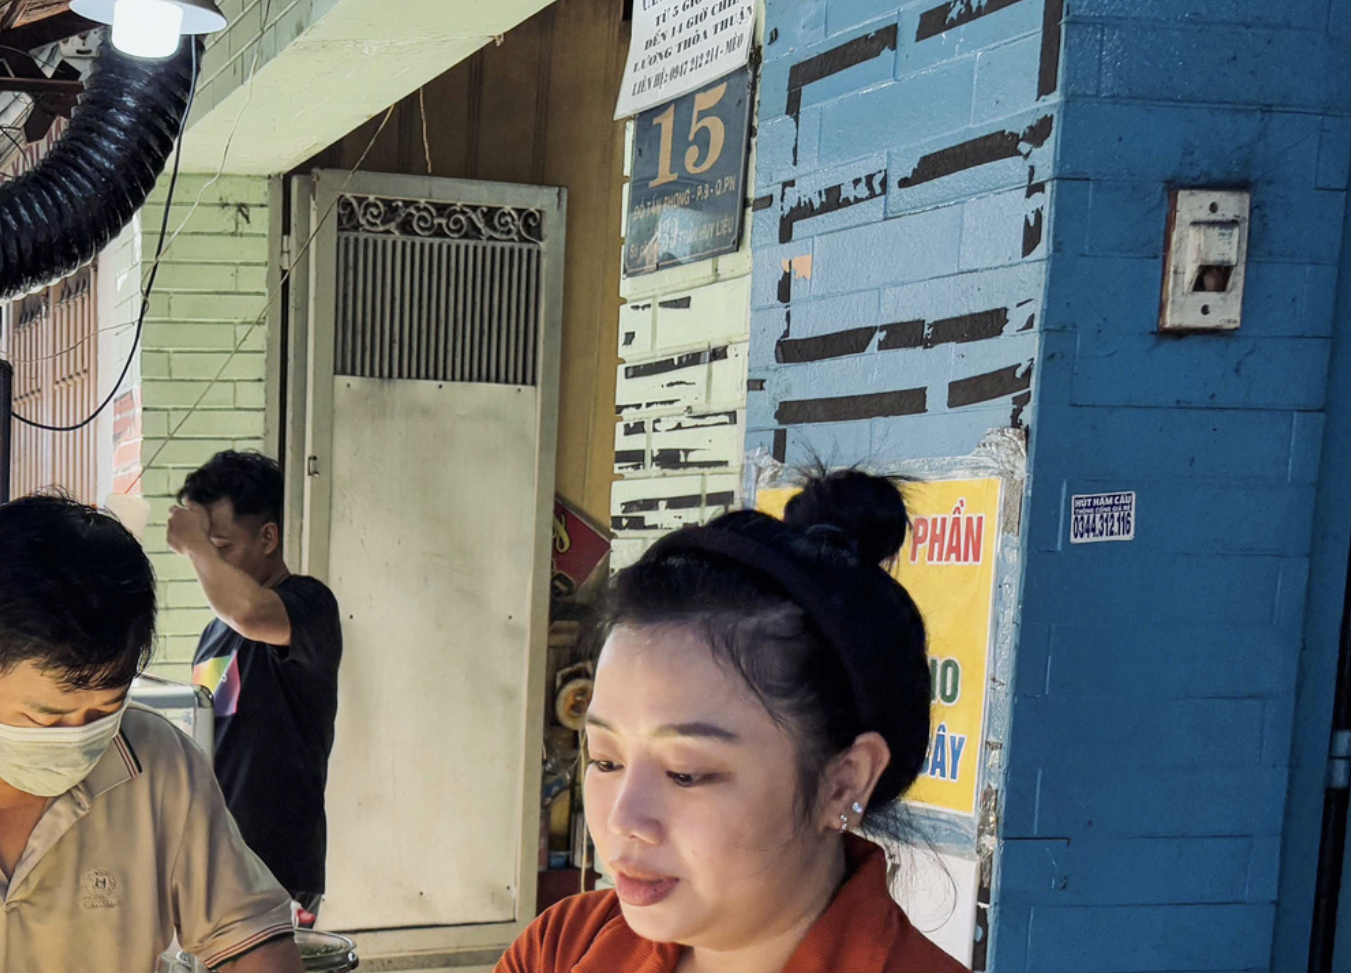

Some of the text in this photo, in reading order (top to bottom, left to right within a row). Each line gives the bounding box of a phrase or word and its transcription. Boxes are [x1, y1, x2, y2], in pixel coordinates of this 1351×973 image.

[655, 7, 671, 27] TỪ
[672, 5, 679, 18] 5
[671, 22, 683, 38] 14
[686, 7, 709, 30] GIỜ
[633, 45, 672, 73] LƯƠNG
[649, 82, 728, 188] 15
[909, 497, 984, 565] PHẦN
[1074, 512, 1132, 539] 0344.312.116
[923, 722, 967, 781] ÂY
